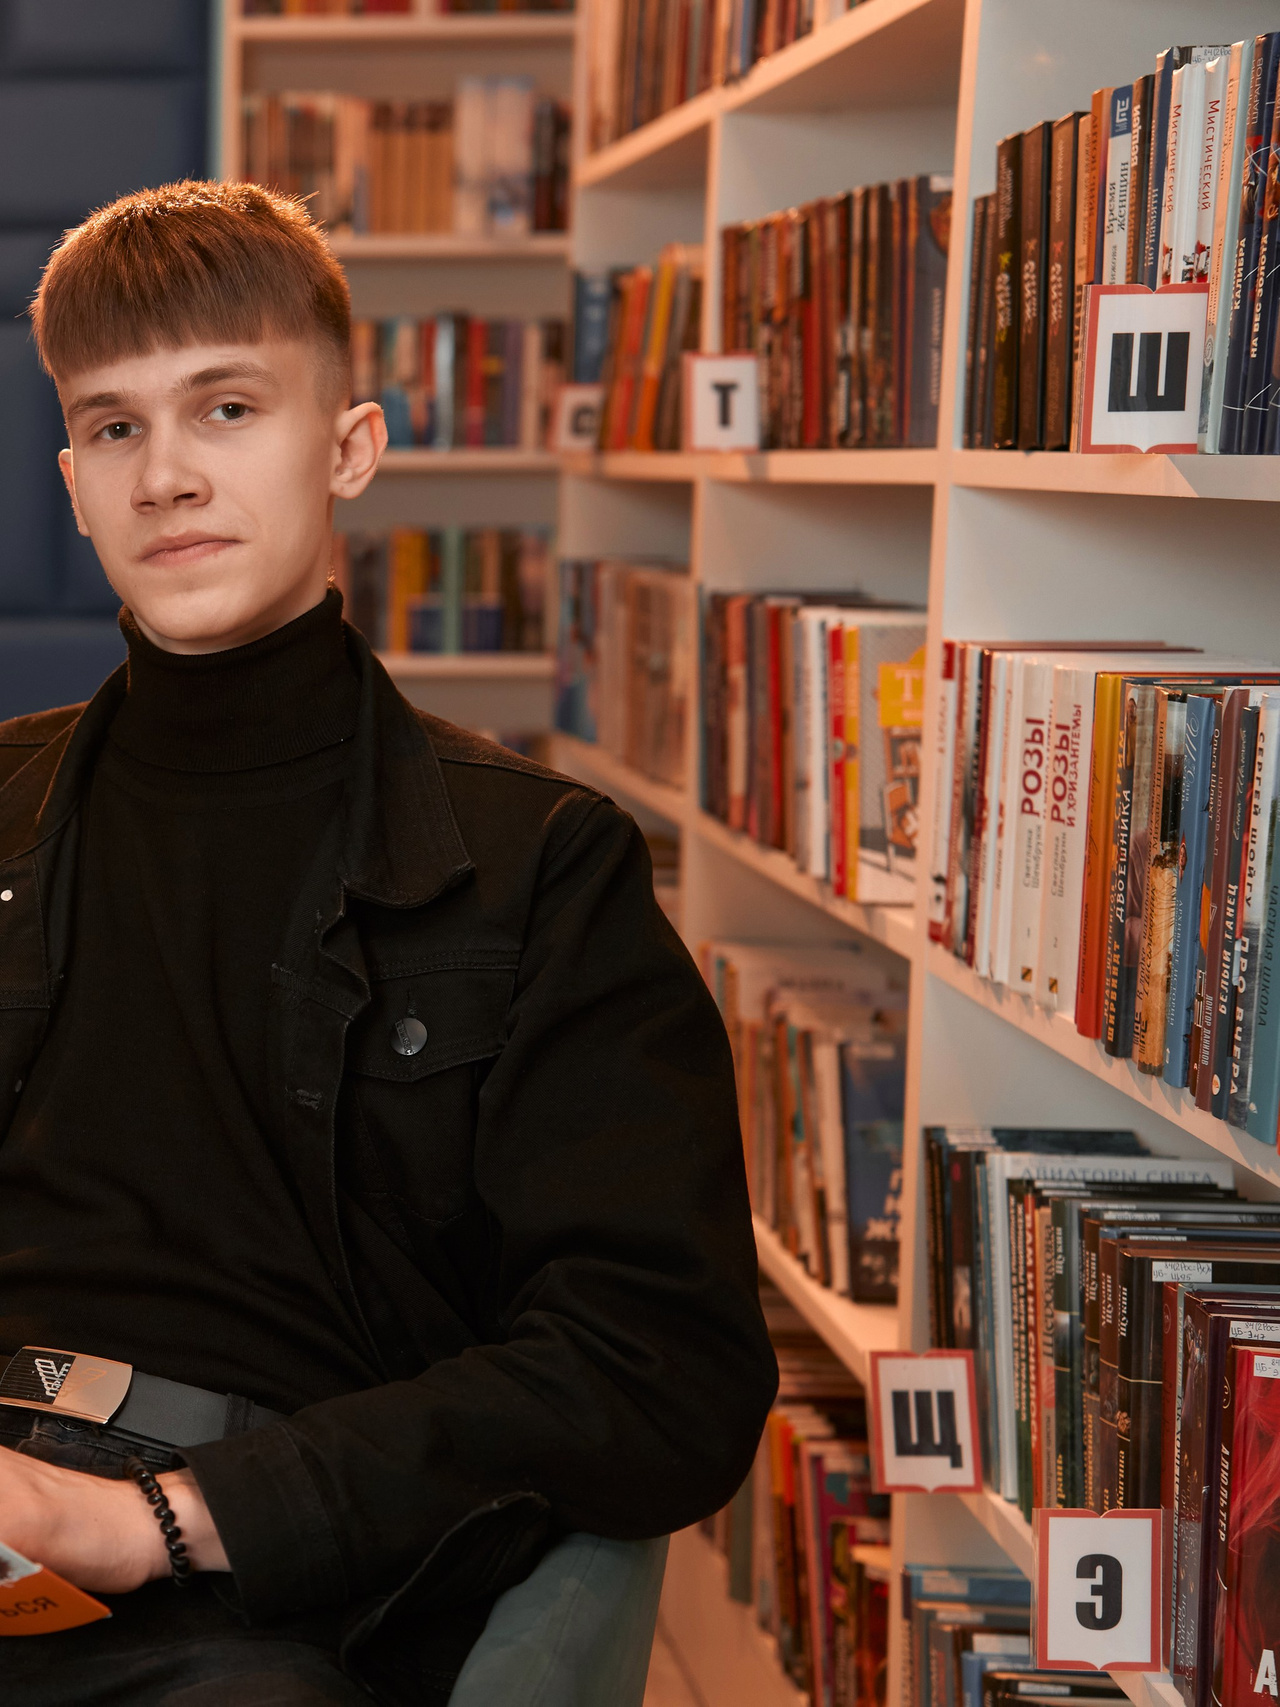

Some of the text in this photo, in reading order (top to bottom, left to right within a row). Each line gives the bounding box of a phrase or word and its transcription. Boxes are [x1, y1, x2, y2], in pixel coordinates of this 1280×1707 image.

[1252, 56, 1264, 125] ШАРАПОВ
[1201, 99, 1221, 211] Мистический
[1105, 182, 1117, 235] Время
[1234, 238, 1246, 310] КАЛИБРА
[1250, 234, 1269, 358] НА ВЕС ЗОЛОТА
[712, 381, 740, 430] Т
[1108, 331, 1190, 413] Ш
[1020, 717, 1045, 816] РОЗЫ
[1050, 722, 1071, 825] РОЗЫ
[1066, 704, 1082, 827] И ХРИЗАНТЕМЫ
[1208, 728, 1221, 820] Ольга Шлихт
[1116, 789, 1131, 923] ДВОЕШНИКА
[1152, 792, 1161, 851] Михаил
[1246, 732, 1265, 908] СЕРГЕЙ ШОЙГУ
[1050, 836, 1060, 896] Светлана
[1218, 883, 1239, 1015] БЕЛЫЙ ТАНЕЦ
[1258, 884, 1279, 1027] ЧАСТНАЯ ШКОЛА
[1107, 940, 1120, 1042] ШИРВИНДТ
[1201, 994, 1214, 1066] ДОКТОР ДАНИЛОВ
[1229, 936, 1250, 1095] ПРО ВЧЕРА
[1145, 1169, 1214, 1185] СВЕТА
[1089, 1252, 1099, 1301] Щукин
[1106, 1274, 1115, 1325] Щукин
[892, 1389, 963, 1469] Щ
[1075, 1553, 1123, 1630] Э
[1253, 1648, 1278, 1698] А
